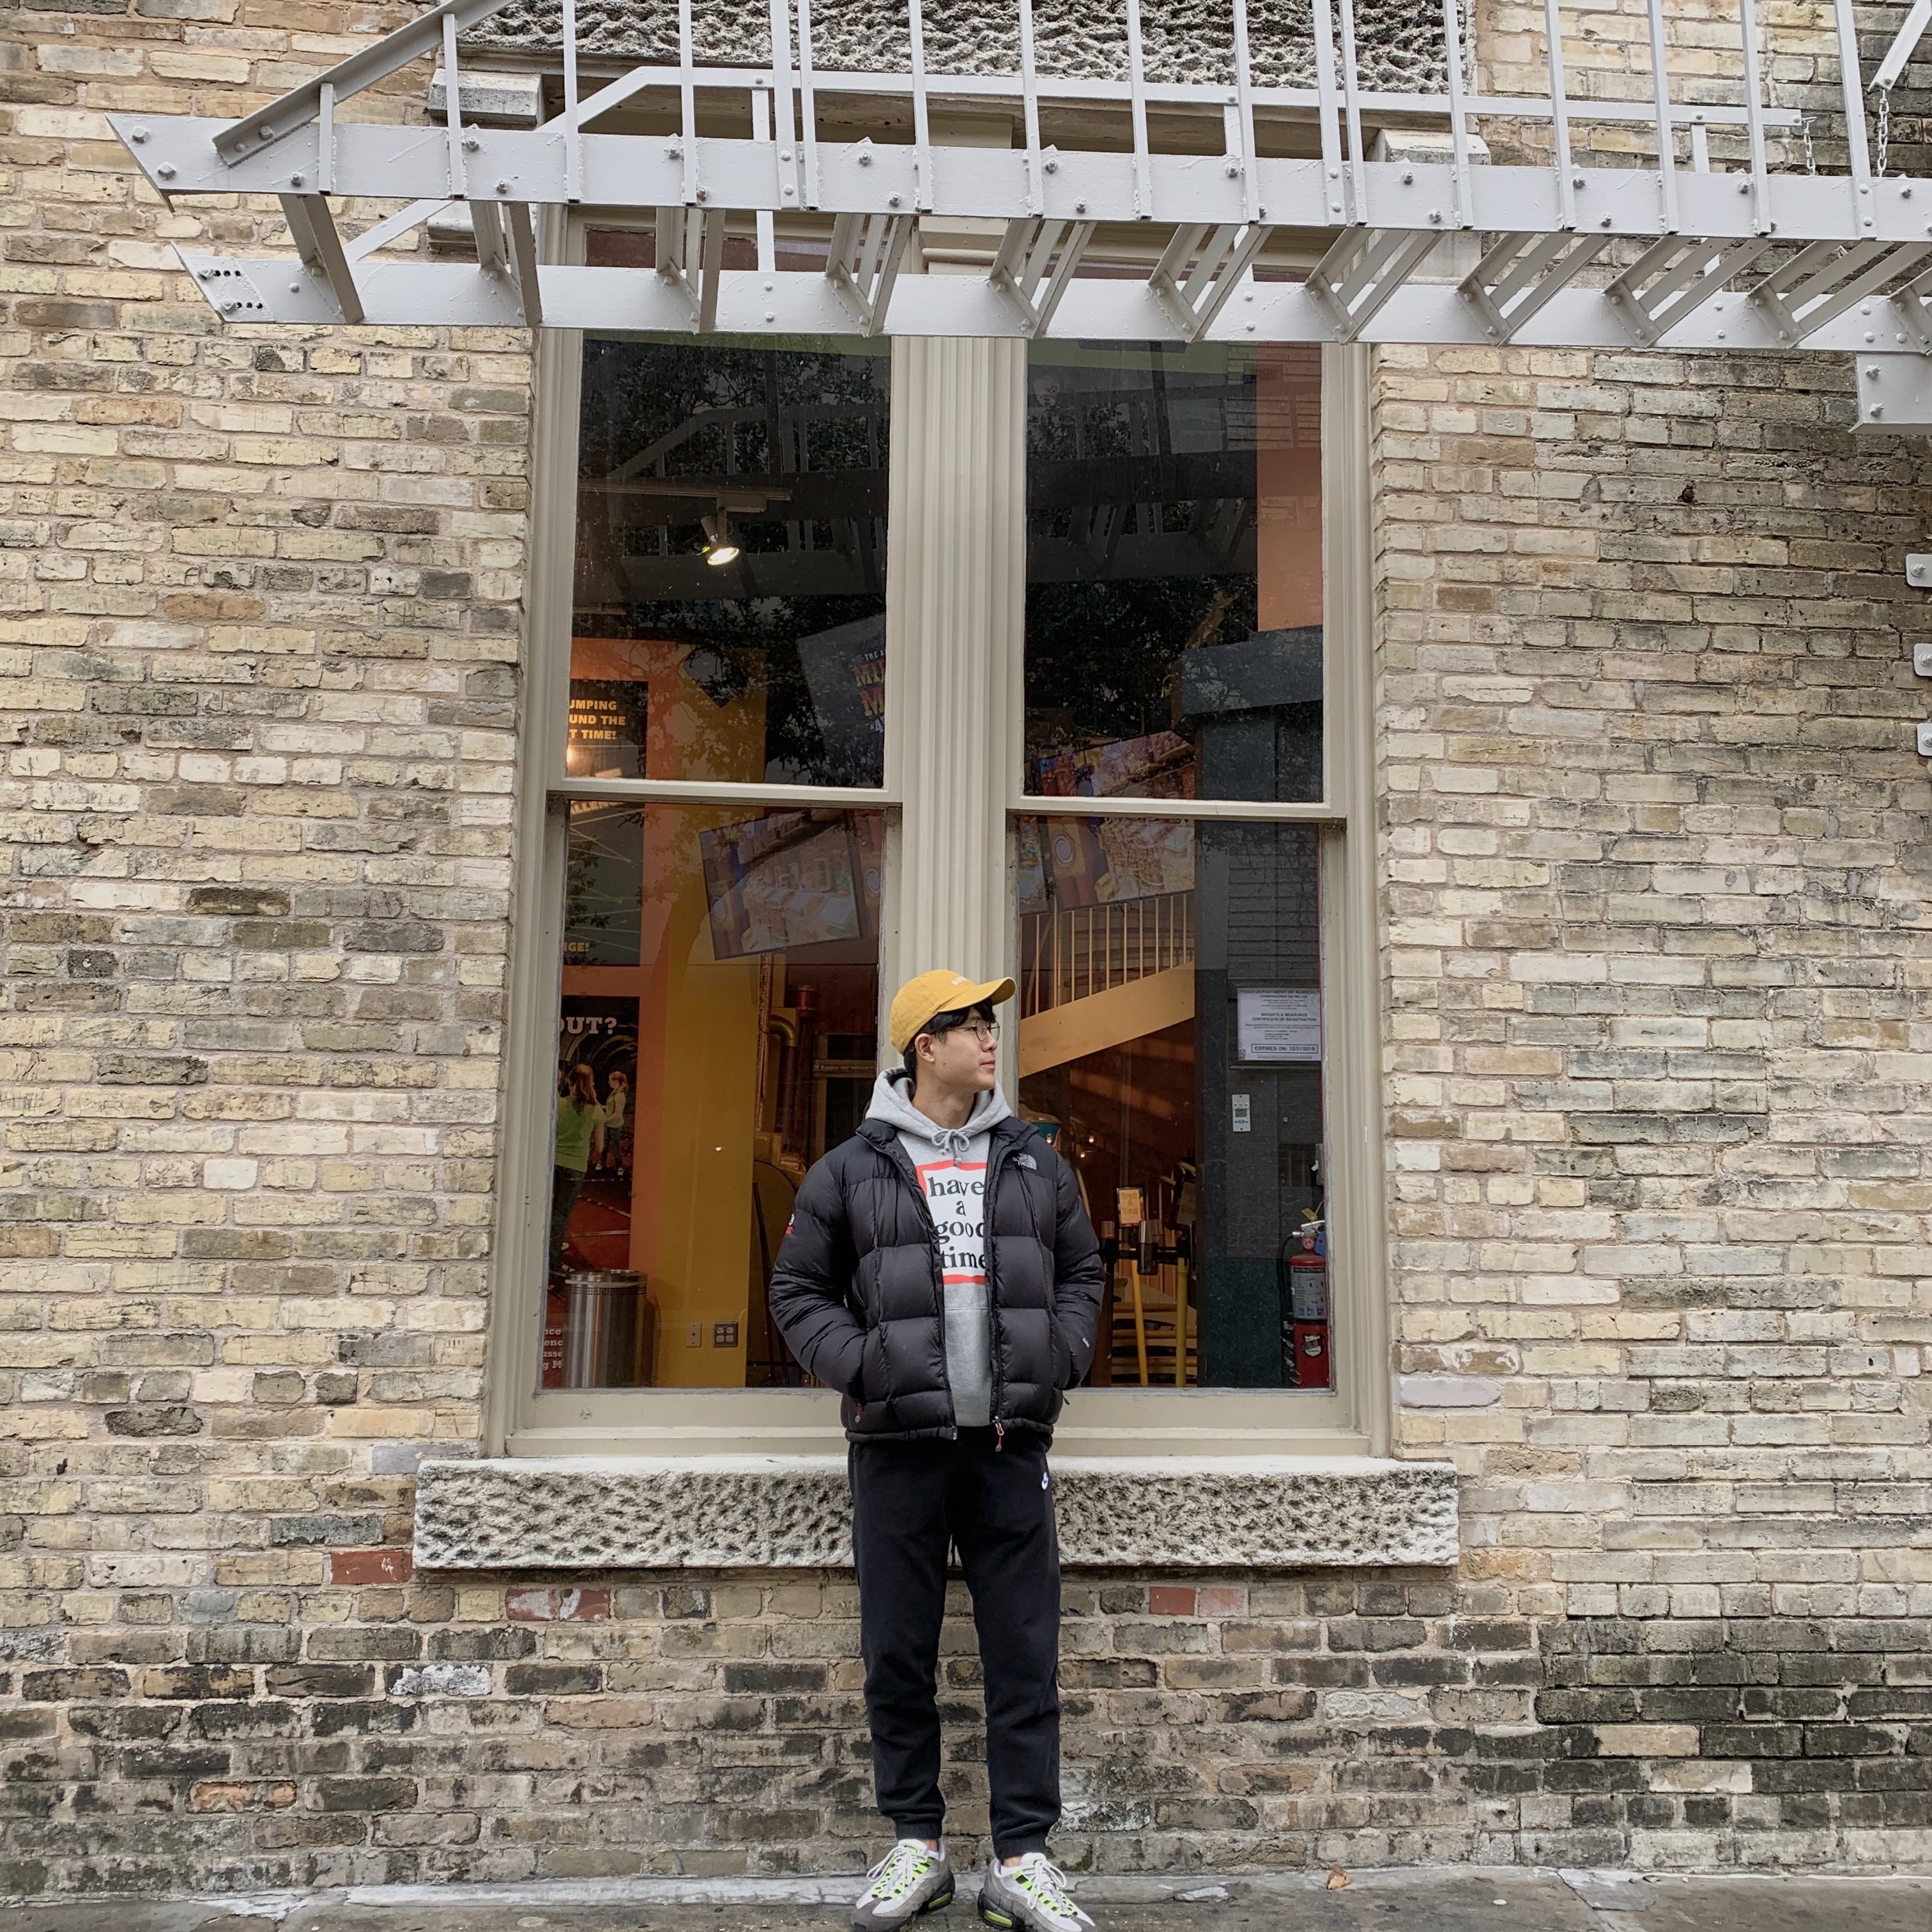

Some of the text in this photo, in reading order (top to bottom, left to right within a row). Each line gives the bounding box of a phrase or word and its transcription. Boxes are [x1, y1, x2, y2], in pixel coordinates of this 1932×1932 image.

[864, 652, 878, 661] THE
[569, 714, 626, 725] UND THE
[569, 729, 617, 740] T TIME!
[927, 1176, 985, 1197] have
[956, 1200, 966, 1216] a
[941, 1246, 986, 1269] time
